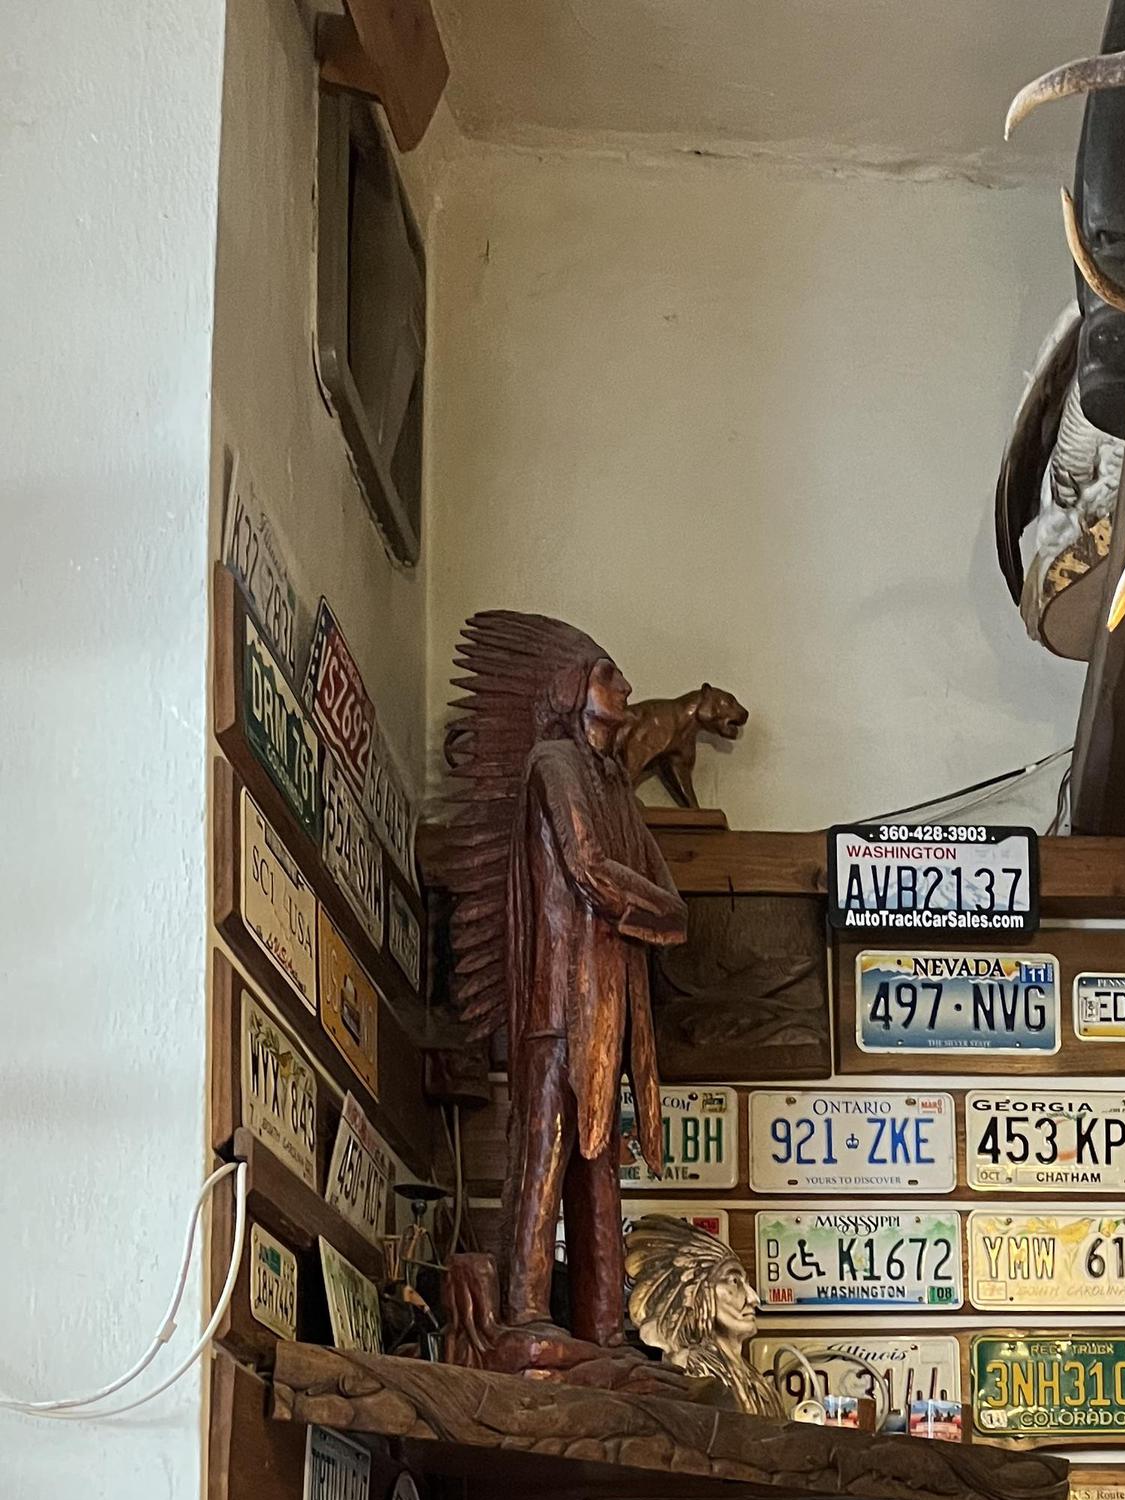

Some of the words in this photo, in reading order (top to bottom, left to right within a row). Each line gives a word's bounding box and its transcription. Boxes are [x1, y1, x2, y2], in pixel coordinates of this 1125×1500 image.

[252, 654, 288, 766] DRM
[292, 722, 317, 815] 761
[846, 845, 957, 861] WASHINGTON
[845, 864, 1023, 911] AVB2137
[845, 910, 1024, 929] AutoTrackCarSales.com
[912, 957, 1006, 979] NEVADA
[249, 1030, 281, 1118] WYX
[290, 1079, 315, 1154] 843
[812, 1099, 892, 1116] ONTARIO
[972, 1099, 1094, 1113] GEORGIA
[805, 1176, 838, 1186] YOURS
[839, 1176, 852, 1185] TO
[853, 1176, 902, 1186] DISCOVER
[980, 1170, 1001, 1182] OCT
[1036, 1171, 1102, 1183] CHATHAM
[837, 1238, 954, 1283] K1672
[982, 1236, 1056, 1280] YMW
[816, 1285, 906, 1299] WASHINGTON
